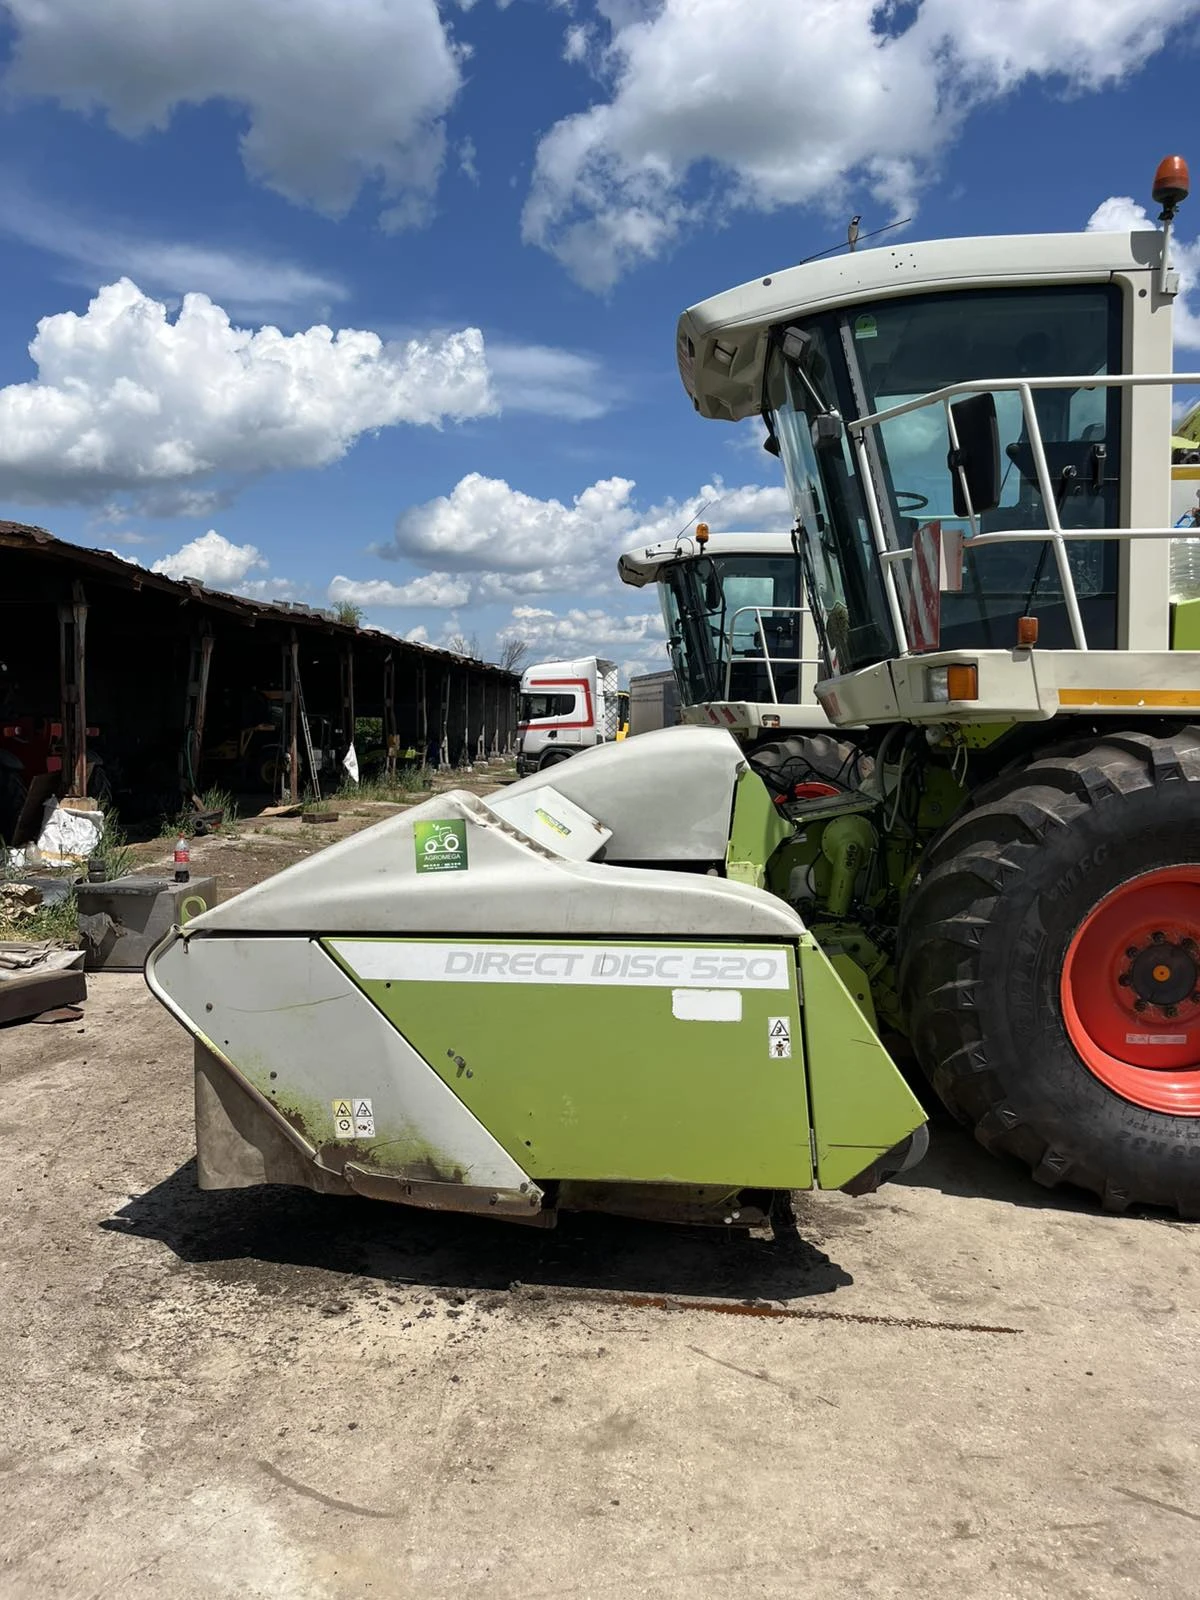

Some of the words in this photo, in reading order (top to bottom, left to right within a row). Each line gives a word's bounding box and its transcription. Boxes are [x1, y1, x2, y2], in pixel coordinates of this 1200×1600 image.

[424, 853, 462, 861] AGROMEGA
[443, 951, 584, 977] DIRECT
[590, 953, 683, 979] DISC
[690, 956, 777, 981] 520
